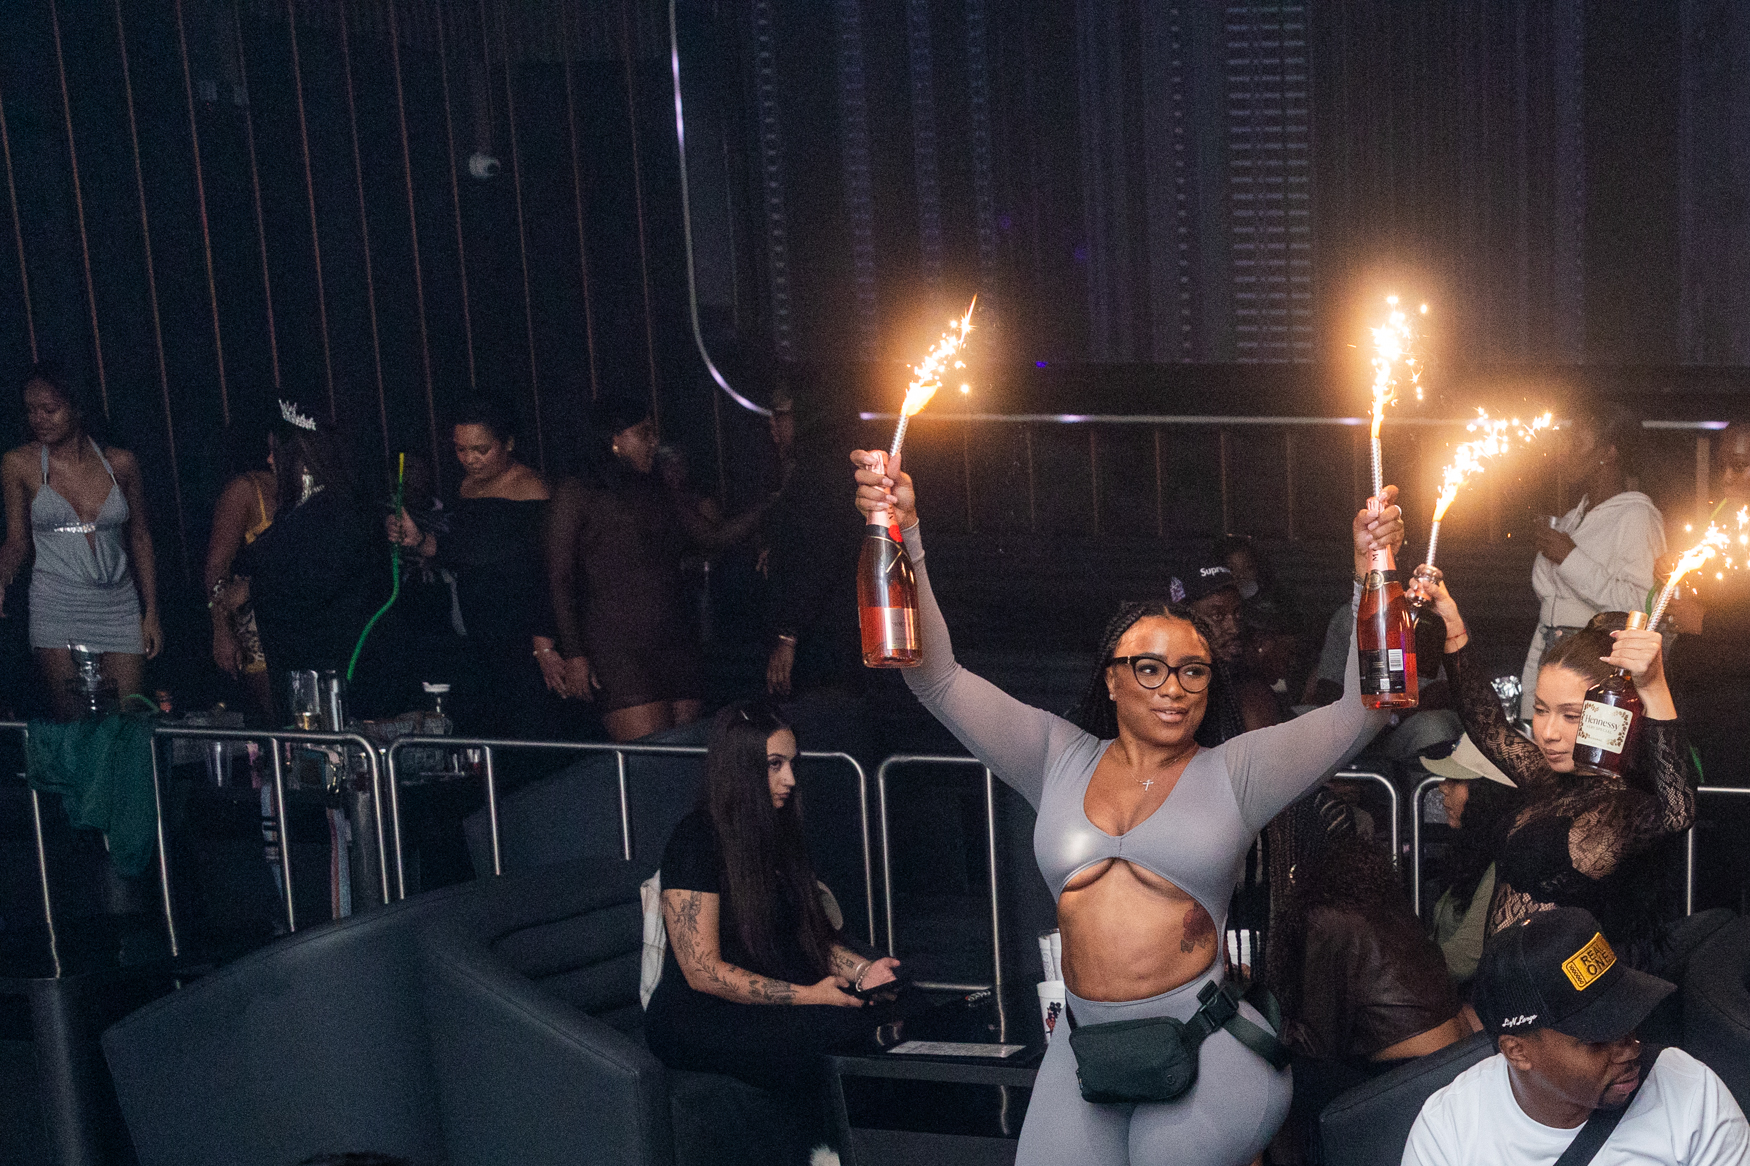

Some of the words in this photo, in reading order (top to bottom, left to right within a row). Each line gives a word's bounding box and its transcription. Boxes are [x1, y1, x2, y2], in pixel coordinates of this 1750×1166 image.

[1199, 566, 1231, 577] Supr
[1585, 714, 1620, 732] Hennessy
[1580, 943, 1604, 966] REAL
[1587, 951, 1610, 976] ONE
